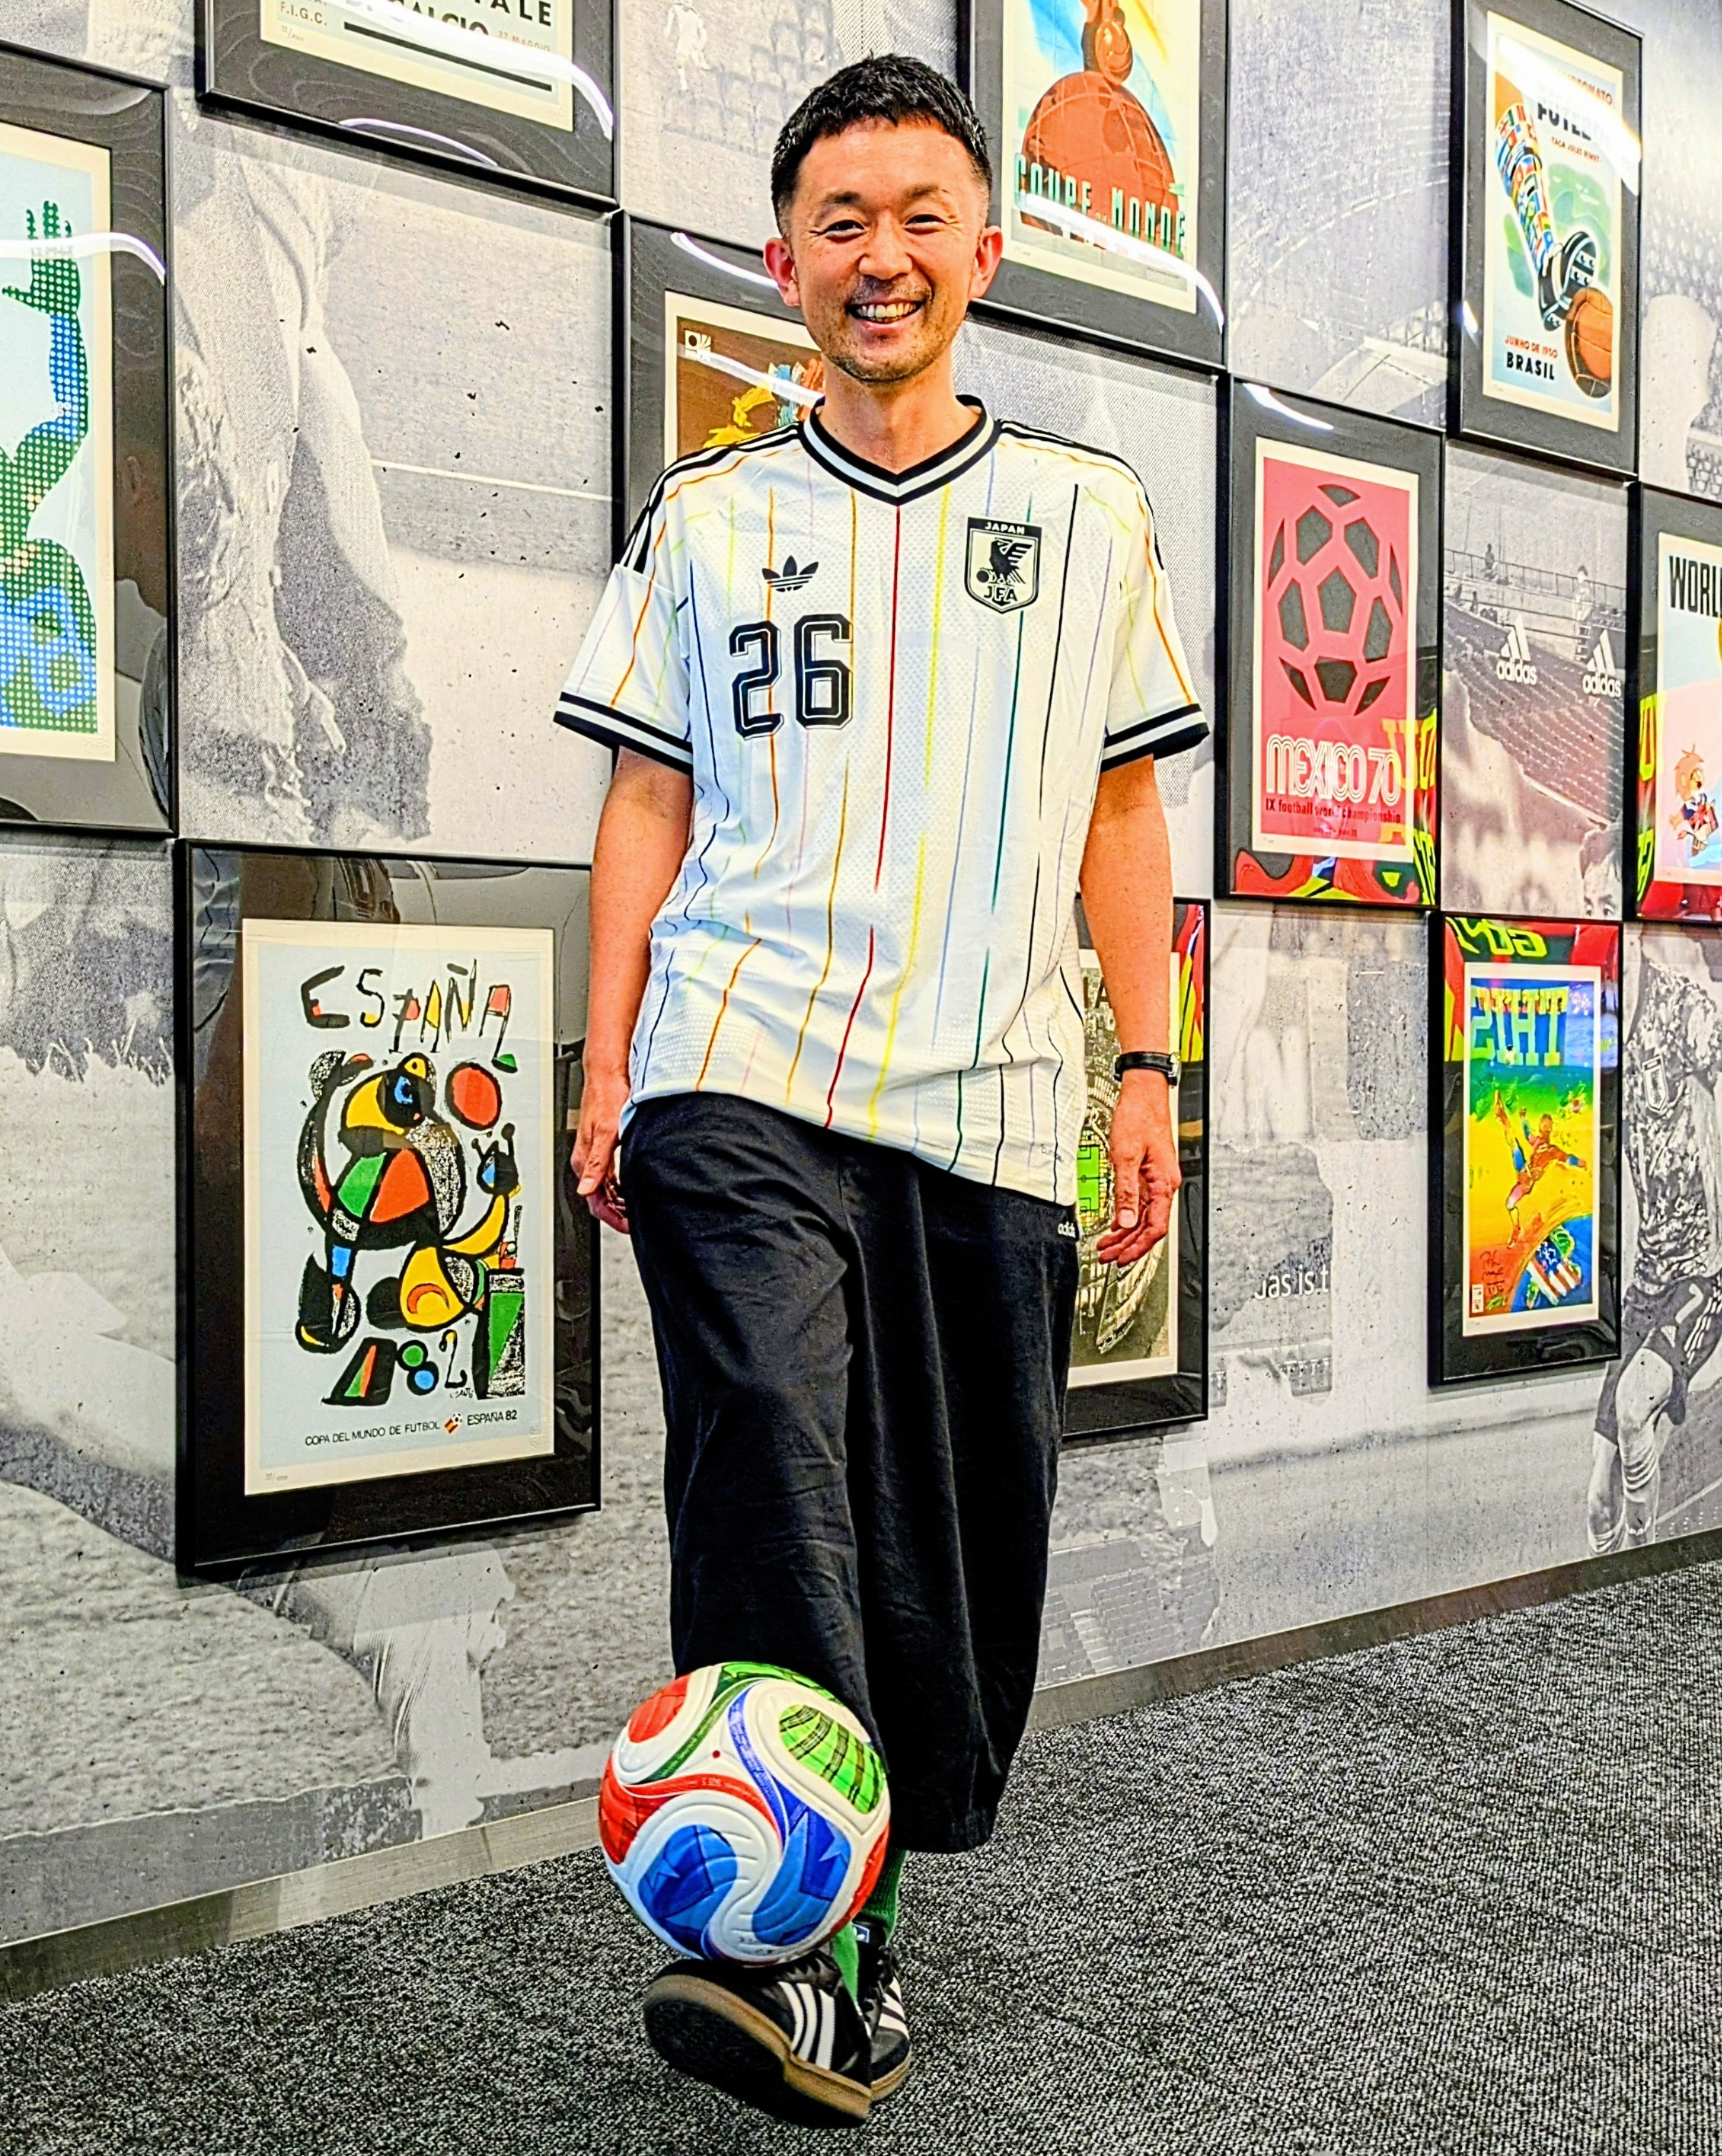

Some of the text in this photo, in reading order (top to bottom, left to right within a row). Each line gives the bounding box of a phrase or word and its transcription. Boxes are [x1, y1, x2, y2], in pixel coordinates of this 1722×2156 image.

[280, 1, 327, 26] F.I.G.C.
[1111, 186, 1186, 260] MONDE
[1504, 334, 1558, 359] JUNHO DE 1950
[1506, 351, 1555, 380] BRASIL
[984, 521, 1025, 534] JAPAN
[983, 585, 1018, 602] JFA
[1669, 555, 1722, 619] WORL
[729, 614, 854, 741] 26
[1496, 657, 1538, 686] adidas
[1582, 672, 1622, 698] adidas
[1266, 733, 1367, 804] MEXICO
[1367, 747, 1402, 807] 70
[1266, 798, 1275, 812] IX
[1278, 799, 1313, 815] football
[301, 958, 518, 1074] ESPAÑA
[1298, 1264, 1314, 1296] is
[305, 1409, 518, 1446] COPA DEL MUNDO DE FUTBOL ESPAÑA 82
